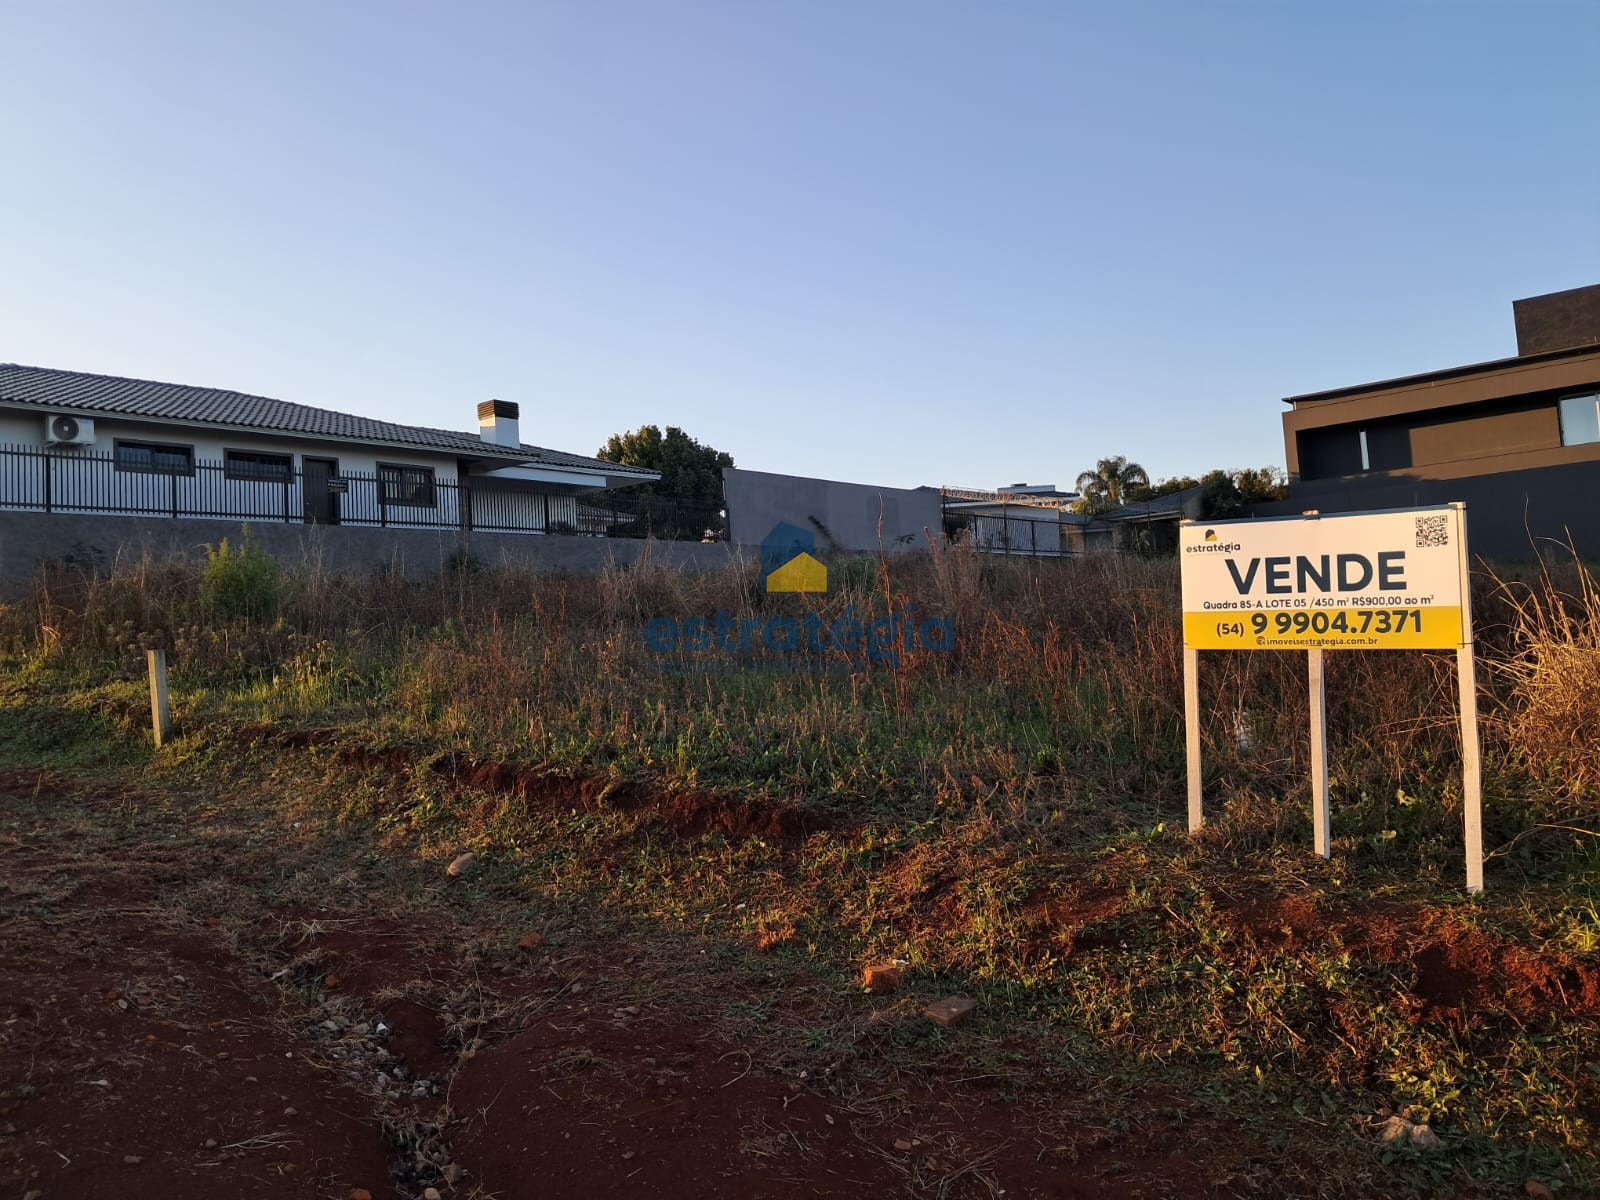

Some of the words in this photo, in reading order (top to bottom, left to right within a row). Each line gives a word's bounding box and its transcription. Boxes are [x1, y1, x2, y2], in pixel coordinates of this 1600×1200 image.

[1186, 541, 1241, 554] estratégia
[1225, 551, 1407, 595] VENDE
[1203, 600, 1238, 610] Quadra
[1240, 599, 1263, 609] 85-A
[1265, 599, 1292, 608] LOTE
[1294, 598, 1307, 608] 05
[1352, 596, 1402, 607] R$900,00
[1405, 597, 1418, 605] ao
[1216, 622, 1244, 638] (54)
[1251, 613, 1268, 635] 9
[1274, 610, 1422, 635] 9904.7371
[1266, 636, 1378, 647] imoveisestrategia.com.br
